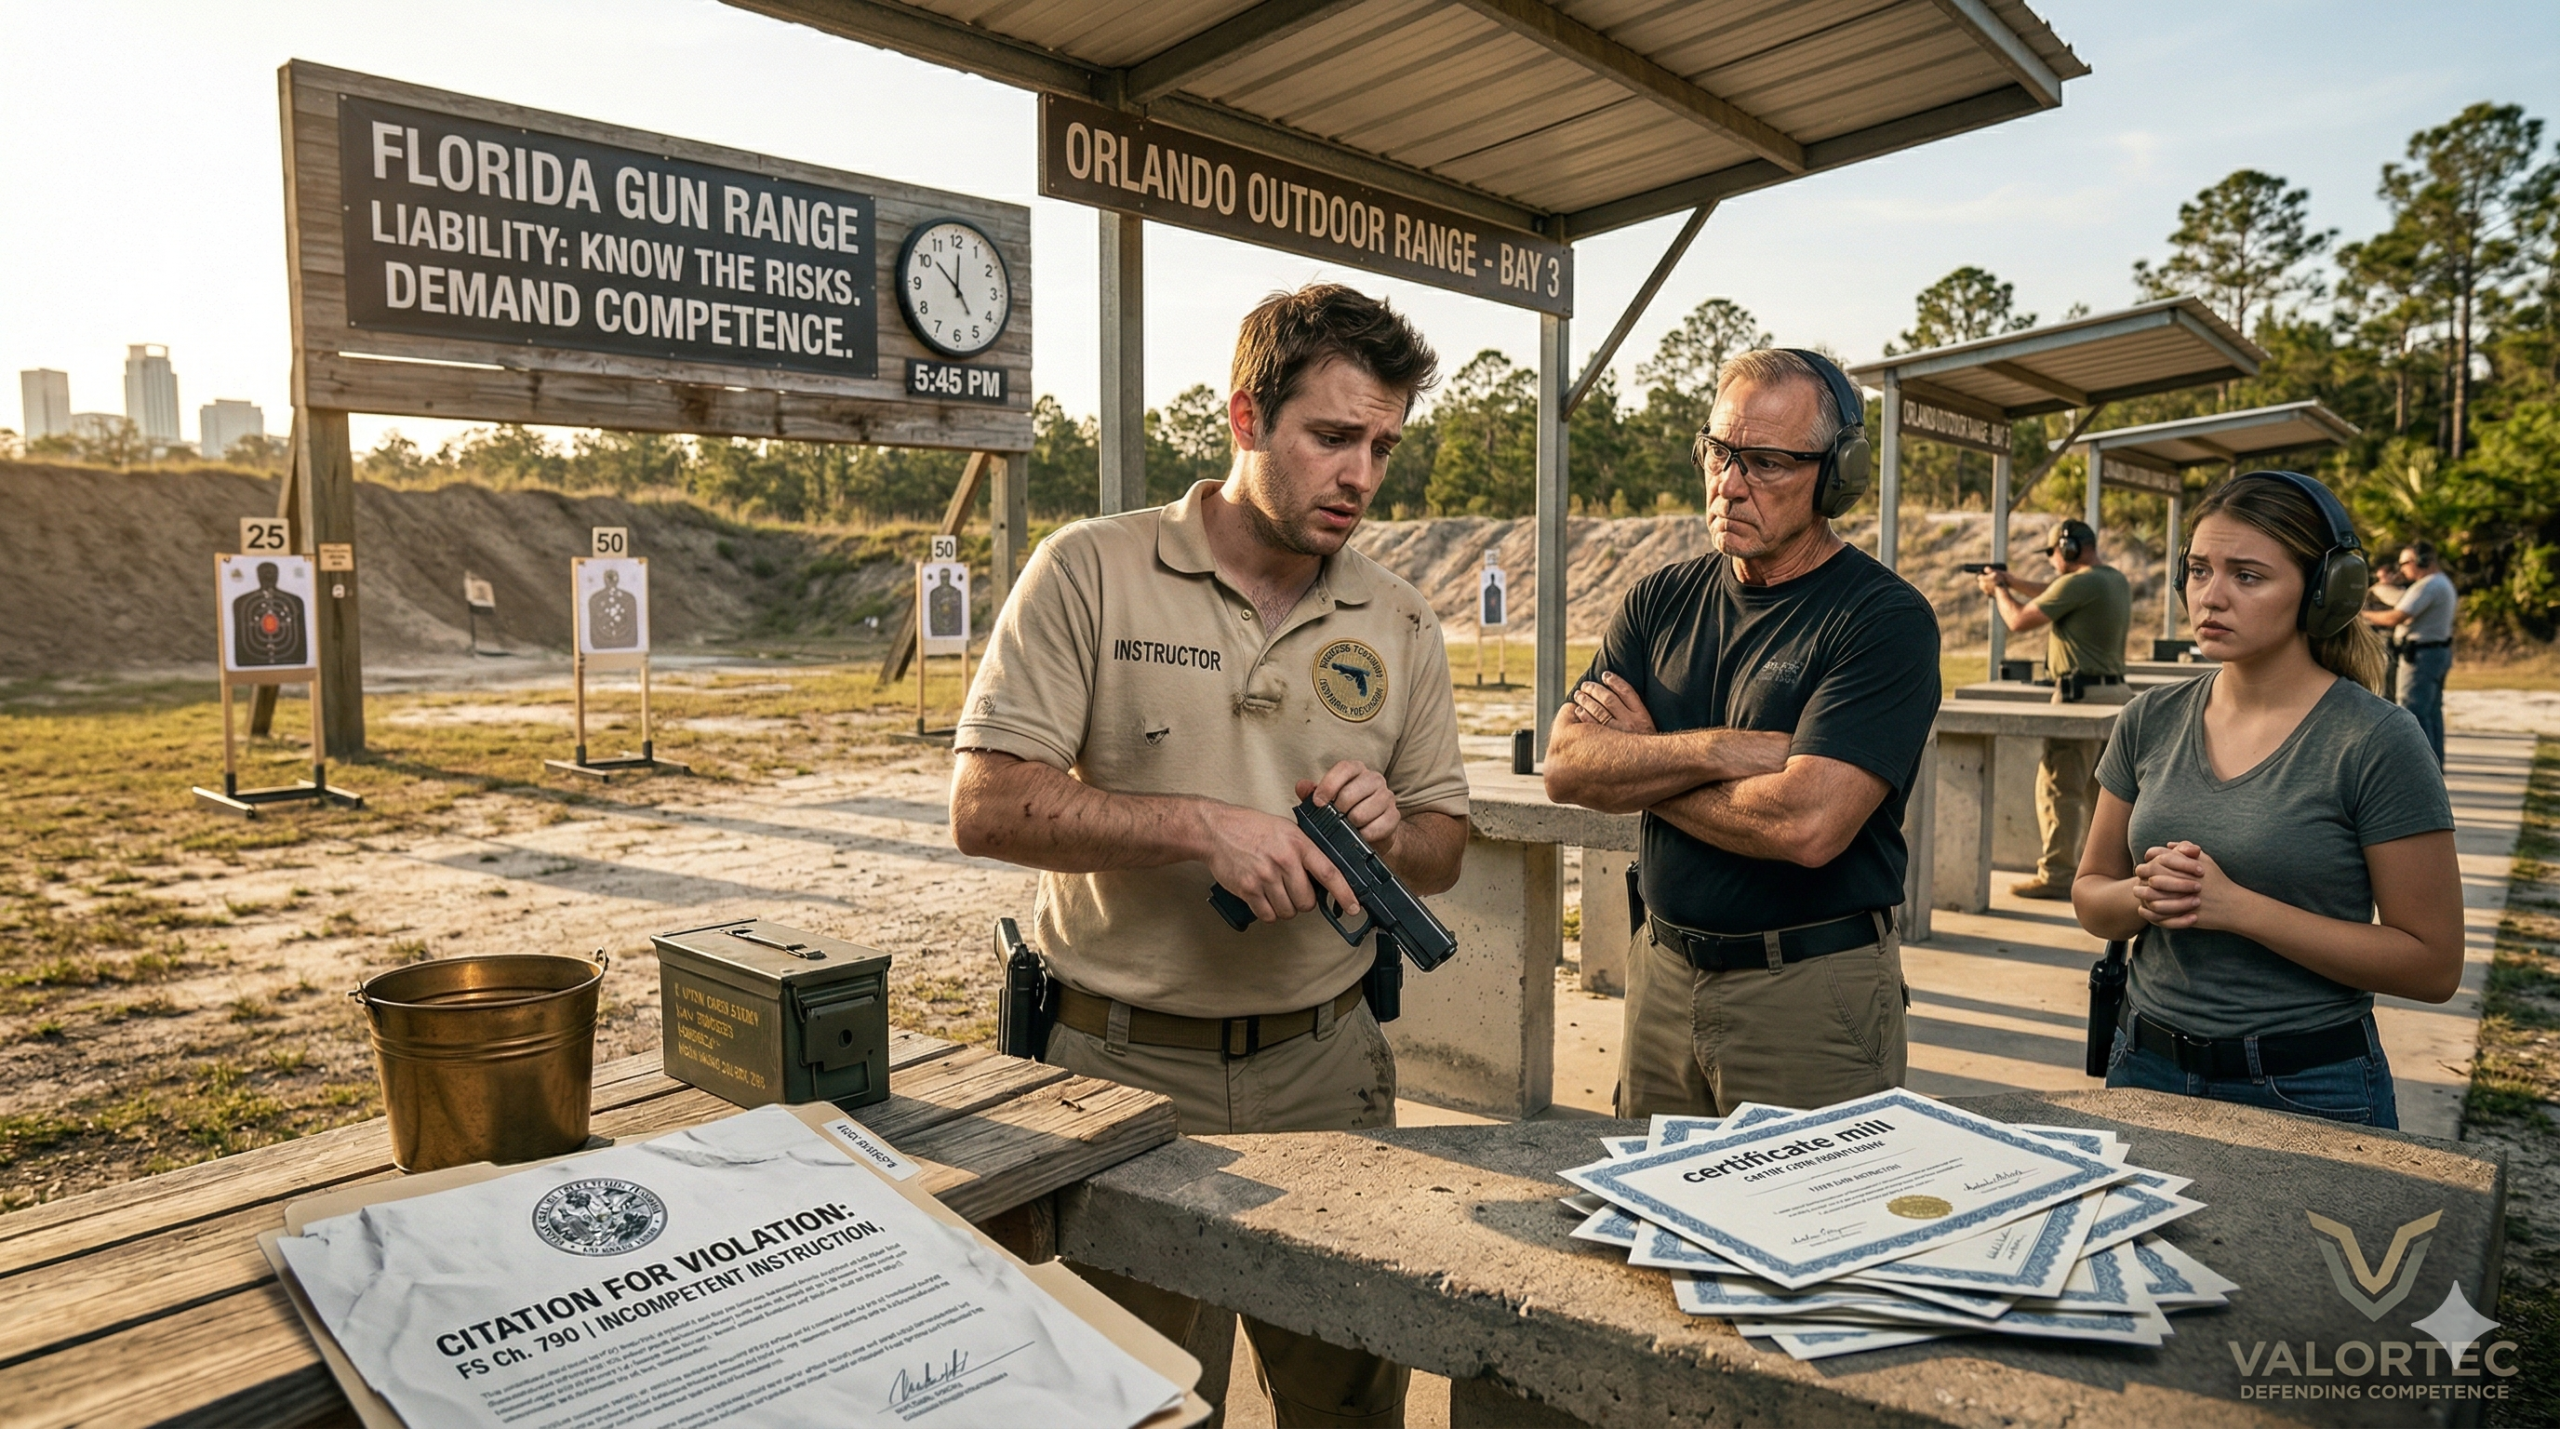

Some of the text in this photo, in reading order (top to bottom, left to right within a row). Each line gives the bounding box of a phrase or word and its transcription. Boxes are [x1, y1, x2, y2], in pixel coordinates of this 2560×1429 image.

[371, 120, 860, 255] FLORIDA GUN RANGE
[1065, 121, 1237, 216] ORLANDO
[1247, 172, 1386, 255] OUTDOOR
[1394, 212, 1478, 278] RANGE
[1499, 242, 1544, 294] BAY
[1546, 256, 1561, 299] 3
[932, 239, 943, 252] 11
[950, 234, 963, 249] 12
[371, 199, 861, 307] LIABILITY: KNOW THE RISKS.
[973, 245, 978, 259] 1
[918, 254, 932, 268] 10
[985, 264, 993, 278] 2
[913, 276, 922, 290] 9
[990, 288, 998, 301] 3
[385, 260, 854, 359] DEMAND COMPETENCE.
[920, 301, 928, 314] 8
[985, 311, 993, 323] 4
[934, 320, 942, 333] 7
[972, 325, 980, 339] 5
[953, 329, 961, 342] 6
[914, 363, 1000, 398] 5:45 PM
[247, 524, 285, 550] 25
[597, 532, 624, 553] 50
[935, 540, 954, 558] 50
[1114, 639, 1221, 672] INSTRUCTOR
[1682, 1137, 1835, 1184] certificate
[1835, 1119, 1896, 1143] mill
[436, 1287, 603, 1357] CITATION
[602, 1264, 677, 1300] FOR
[674, 1202, 856, 1273] VIOLATION:
[456, 1359, 490, 1380] FS
[492, 1347, 534, 1368] Ch.
[534, 1328, 580, 1352] 790
[597, 1264, 760, 1332] INCOMPETENT
[751, 1220, 886, 1278] INSTRUCTION,
